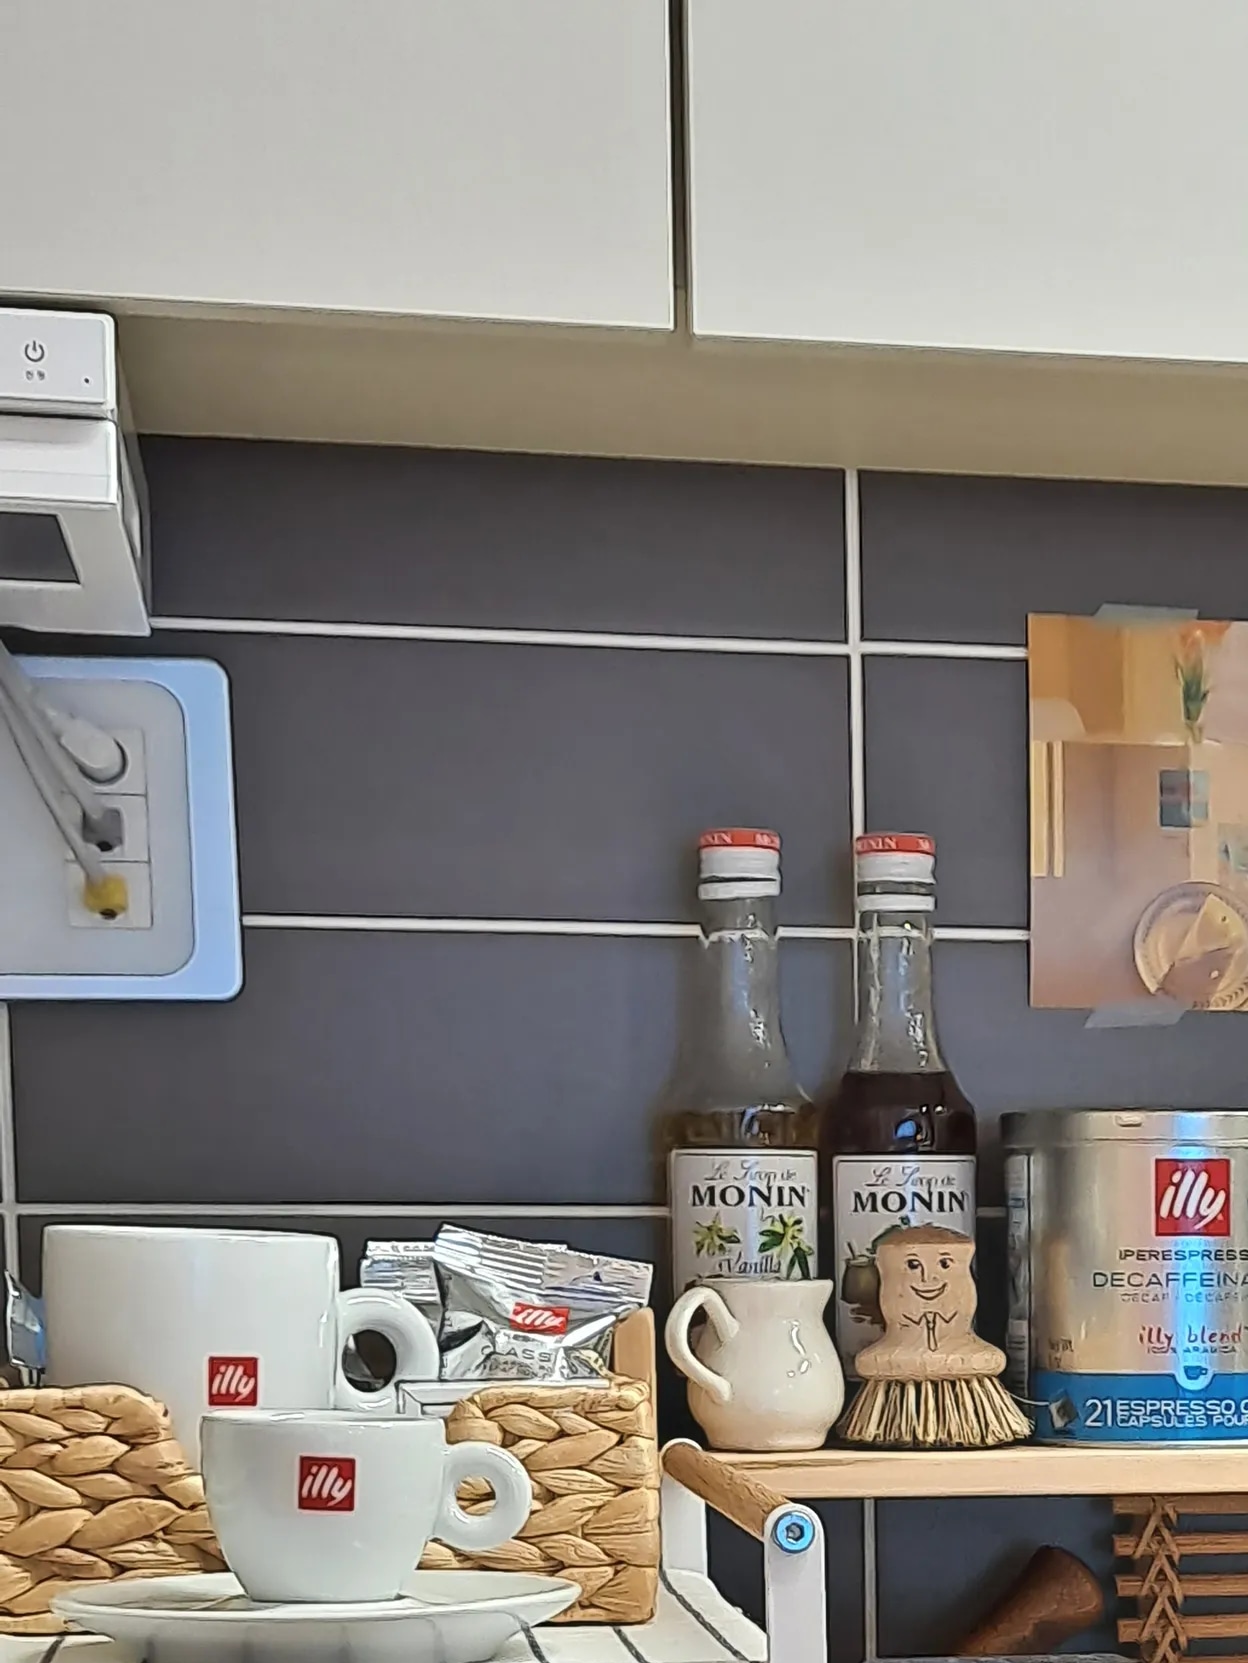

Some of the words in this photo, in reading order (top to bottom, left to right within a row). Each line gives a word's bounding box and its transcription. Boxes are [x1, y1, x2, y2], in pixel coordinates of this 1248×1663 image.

[691, 1185, 807, 1208] MONIN
[852, 1190, 966, 1214] MONIN
[1160, 1168, 1227, 1231] illy
[1138, 1325, 1174, 1347] illy
[1187, 1322, 1242, 1344] blend
[212, 1361, 257, 1398] illy
[1084, 1399, 1113, 1428] 21
[1116, 1399, 1236, 1417] ESPRESSO
[1117, 1415, 1208, 1428] CAPSULES
[302, 1463, 355, 1502] illy
